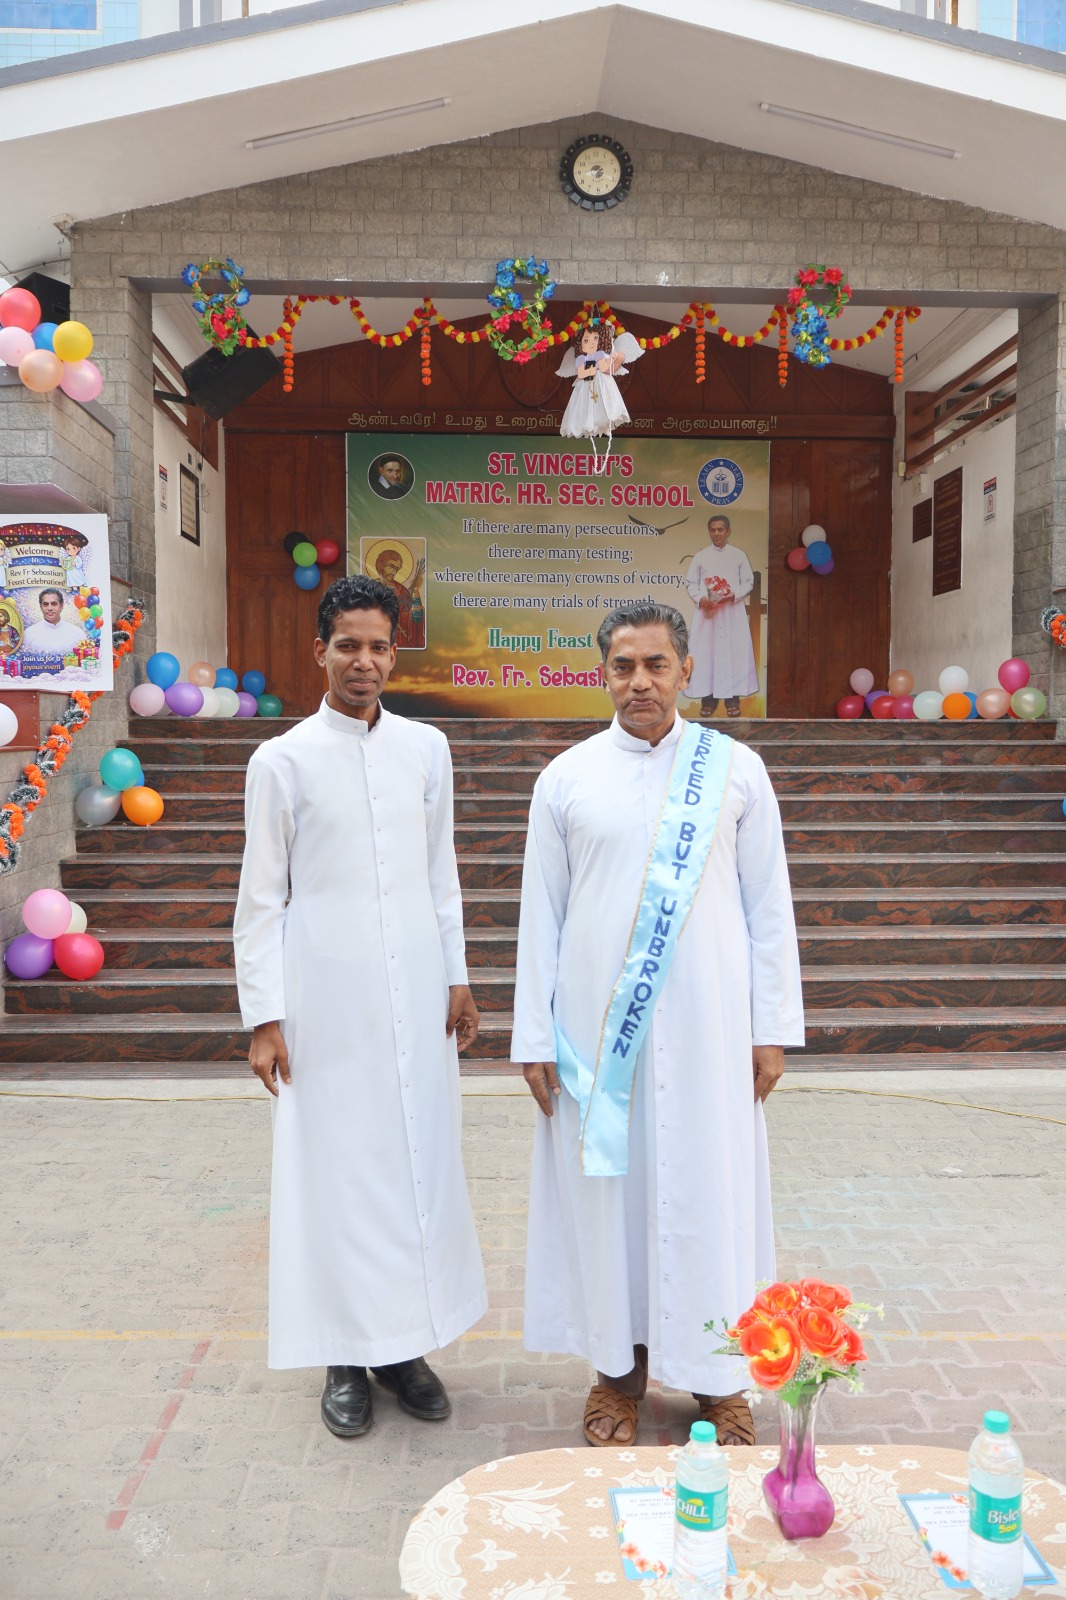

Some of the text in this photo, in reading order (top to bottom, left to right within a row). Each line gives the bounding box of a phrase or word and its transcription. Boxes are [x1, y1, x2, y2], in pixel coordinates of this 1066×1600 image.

[445, 414, 488, 431] உமது
[662, 415, 778, 434] அருமையானது!!
[487, 452, 634, 478] ST. VINCENT'S
[426, 481, 695, 508] MATRIC. HR. SEC. SCHOOL
[711, 497, 730, 505] PRAY
[462, 519, 659, 538] If there are many persecutions,
[15, 546, 54, 556] Welcome
[488, 544, 633, 563] there are many testing;
[10, 569, 22, 577] Rev
[32, 568, 63, 577] Sebastian
[434, 568, 686, 589] where there are many crowns of victory,
[452, 592, 487, 608] there
[489, 597, 510, 608] are
[513, 597, 548, 612] many
[551, 595, 584, 608] trials
[586, 593, 600, 609] of
[488, 627, 594, 652] Happy Feast
[452, 664, 495, 687] Rev.
[502, 664, 532, 687] Fr.
[671, 821, 696, 881] BUT
[612, 896, 678, 1059] UNBROKEN
[676, 1498, 709, 1518] CHILL
